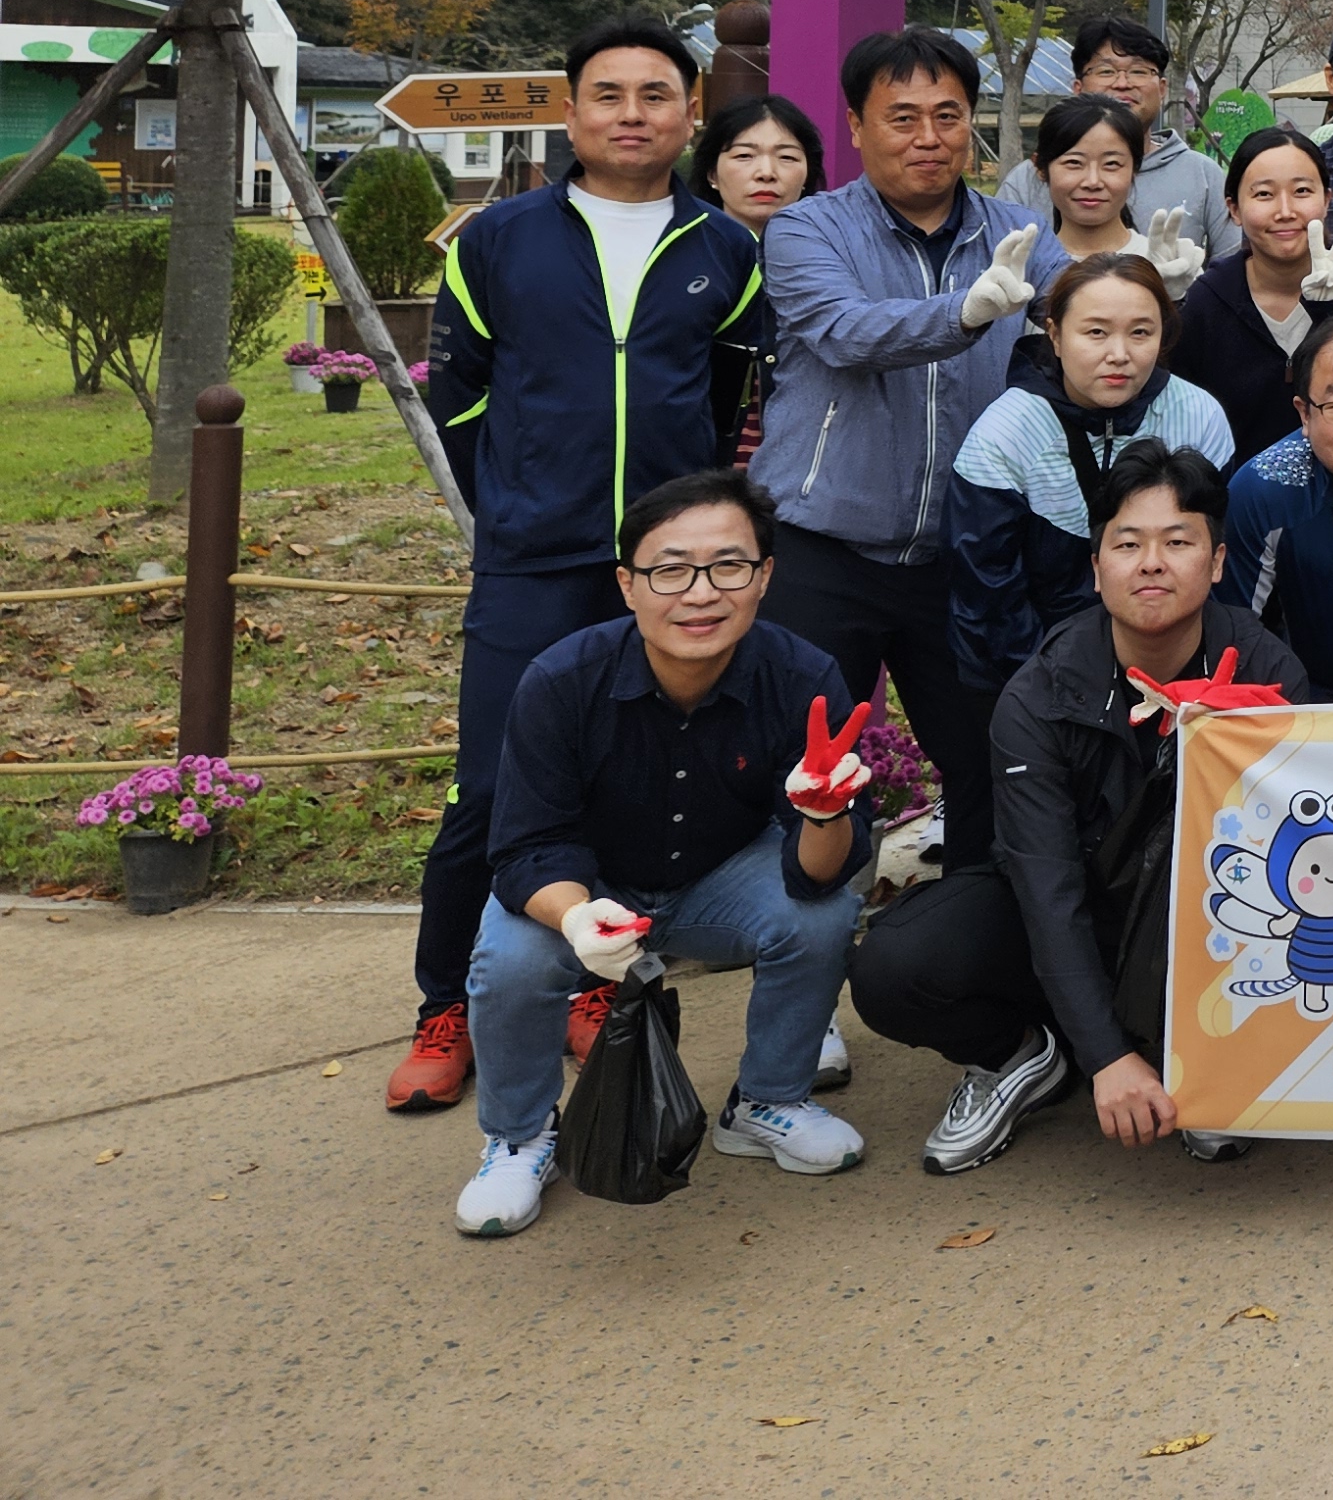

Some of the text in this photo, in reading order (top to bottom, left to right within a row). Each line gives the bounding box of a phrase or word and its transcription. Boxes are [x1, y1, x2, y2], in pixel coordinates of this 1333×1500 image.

[434, 81, 550, 107] 우포늪
[450, 110, 534, 123] Upo Wetland
